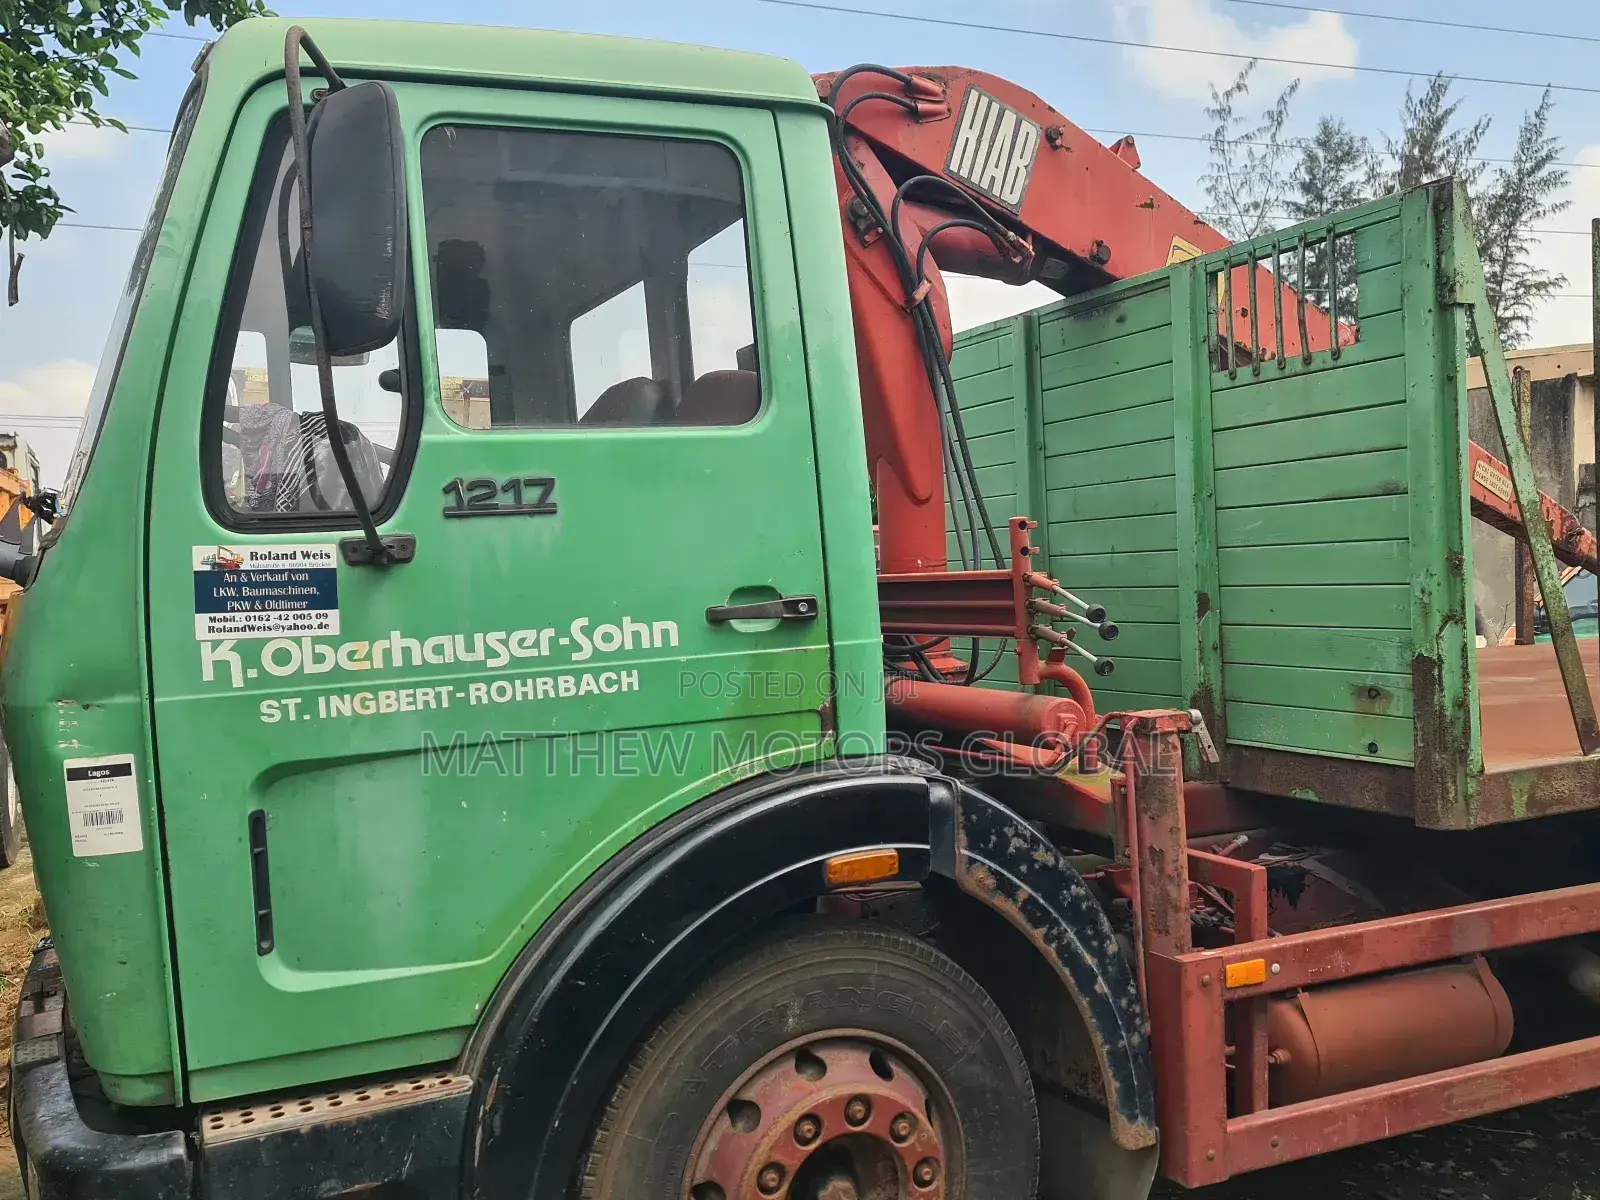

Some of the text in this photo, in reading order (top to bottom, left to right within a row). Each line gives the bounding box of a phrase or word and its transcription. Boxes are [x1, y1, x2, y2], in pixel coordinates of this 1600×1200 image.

[949, 88, 1038, 205] HIAB
[443, 477, 556, 511] 1217
[249, 549, 331, 561] Roland Weis
[223, 571, 309, 583] An & Verkauf von
[213, 585, 320, 598] LKW, Baumaschinen,
[227, 599, 308, 611] PKW & Oldtimer
[208, 614, 242, 624] Mobil.:
[245, 614, 271, 623] 0162
[292, 612, 313, 621] 005
[315, 612, 329, 620] 09
[207, 621, 330, 634] RolandWeis@yahoo.de
[259, 669, 640, 724] ST. INGBERT-ROHRBACH
[87, 768, 110, 778] Lagos
